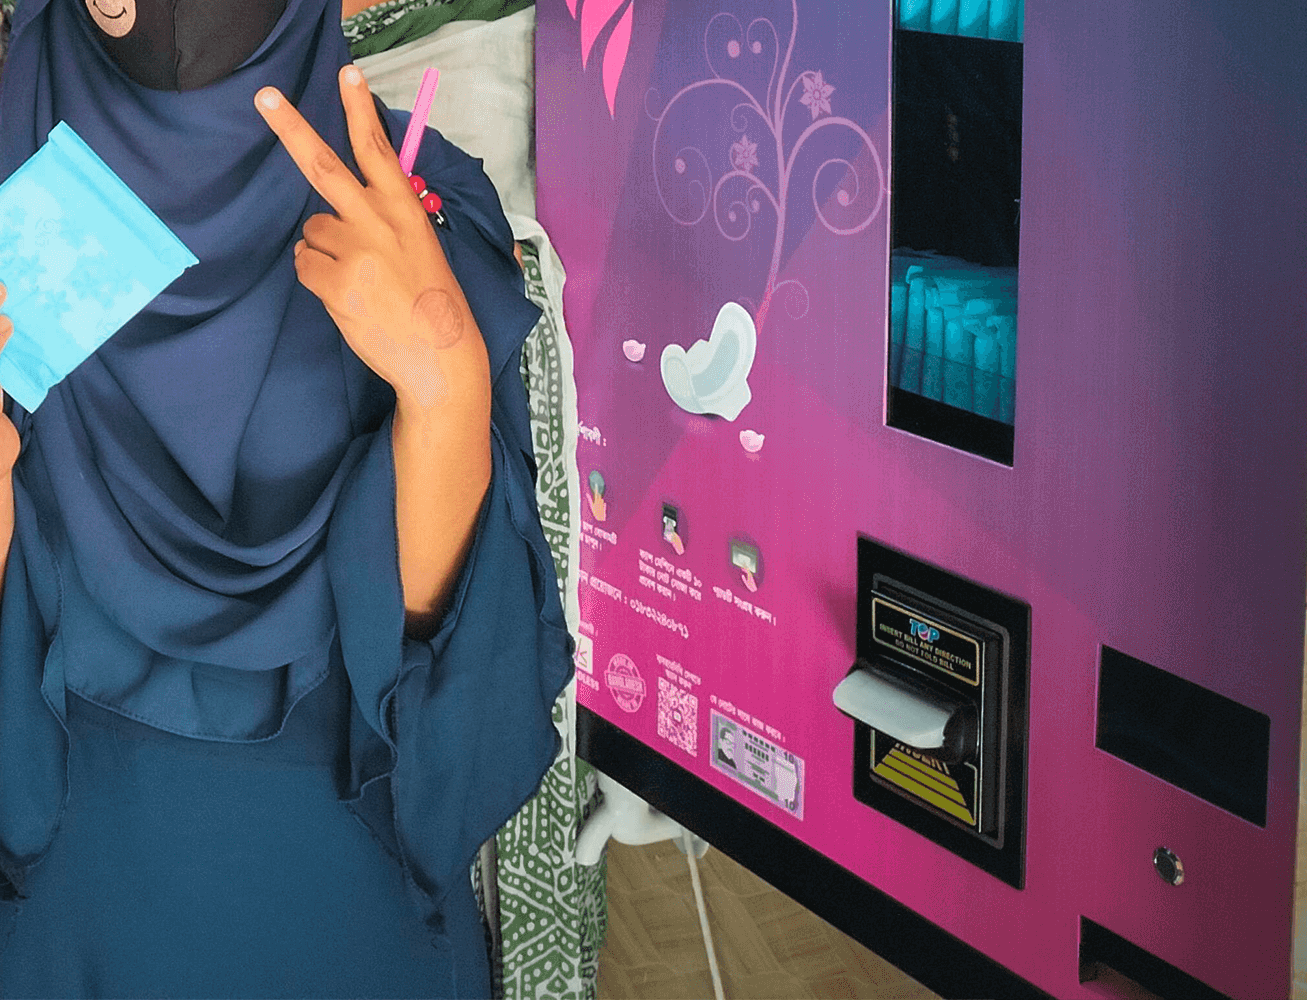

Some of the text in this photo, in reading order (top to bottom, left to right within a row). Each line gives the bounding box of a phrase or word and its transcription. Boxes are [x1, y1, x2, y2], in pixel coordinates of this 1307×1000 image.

[879, 622, 971, 670] INSERT BILL ANY DIRECTION
[905, 643, 919, 657] NOT
[938, 657, 954, 672] BILL
